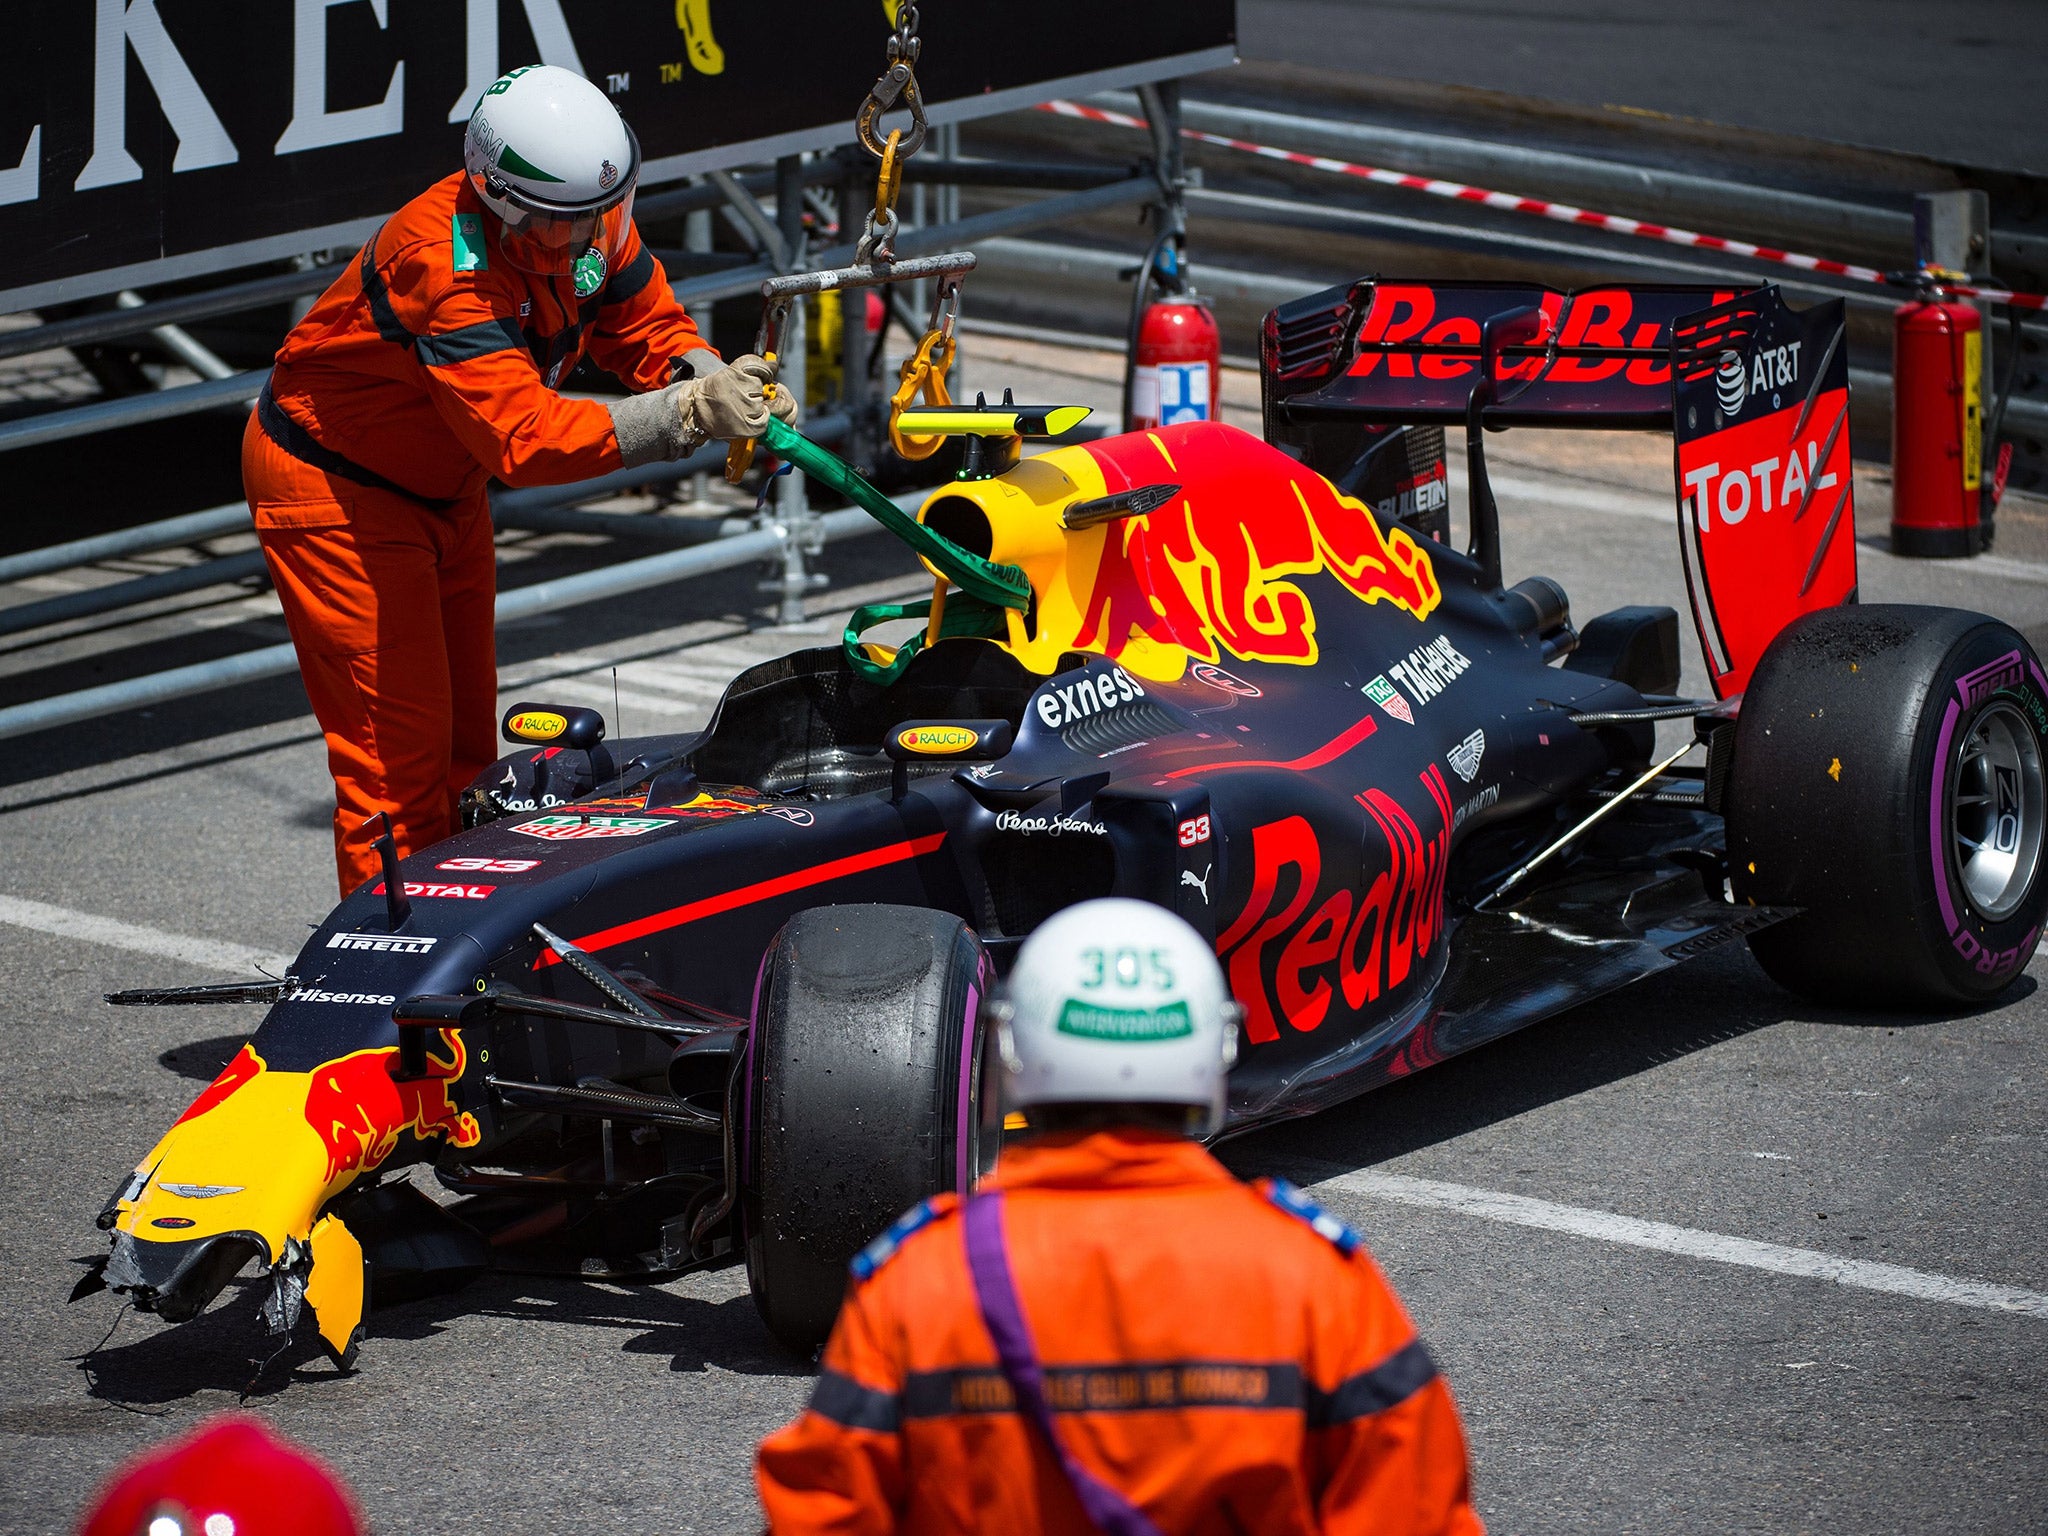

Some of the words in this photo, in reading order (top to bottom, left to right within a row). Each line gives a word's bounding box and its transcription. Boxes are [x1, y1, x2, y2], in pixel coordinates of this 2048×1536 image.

[607, 72, 629, 94] TM
[660, 63, 682, 83] TM
[1751, 341, 1802, 395] AT&T
[1365, 680, 1396, 702] TAG
[1955, 649, 2024, 712] PIRELLI
[1037, 666, 1145, 728] exness
[523, 718, 560, 732] RAUCH
[919, 733, 967, 744] RAUCH
[519, 824, 646, 840] HEUER
[533, 816, 660, 828] TAG
[995, 809, 1048, 837] Pepe
[1048, 812, 1108, 837] Jeans
[1178, 814, 1211, 848] 33
[434, 857, 543, 873] 33
[384, 882, 490, 899] OTAL
[326, 932, 438, 954] PIRELLI
[1080, 945, 1175, 988] 305
[288, 988, 396, 1006] Hisense
